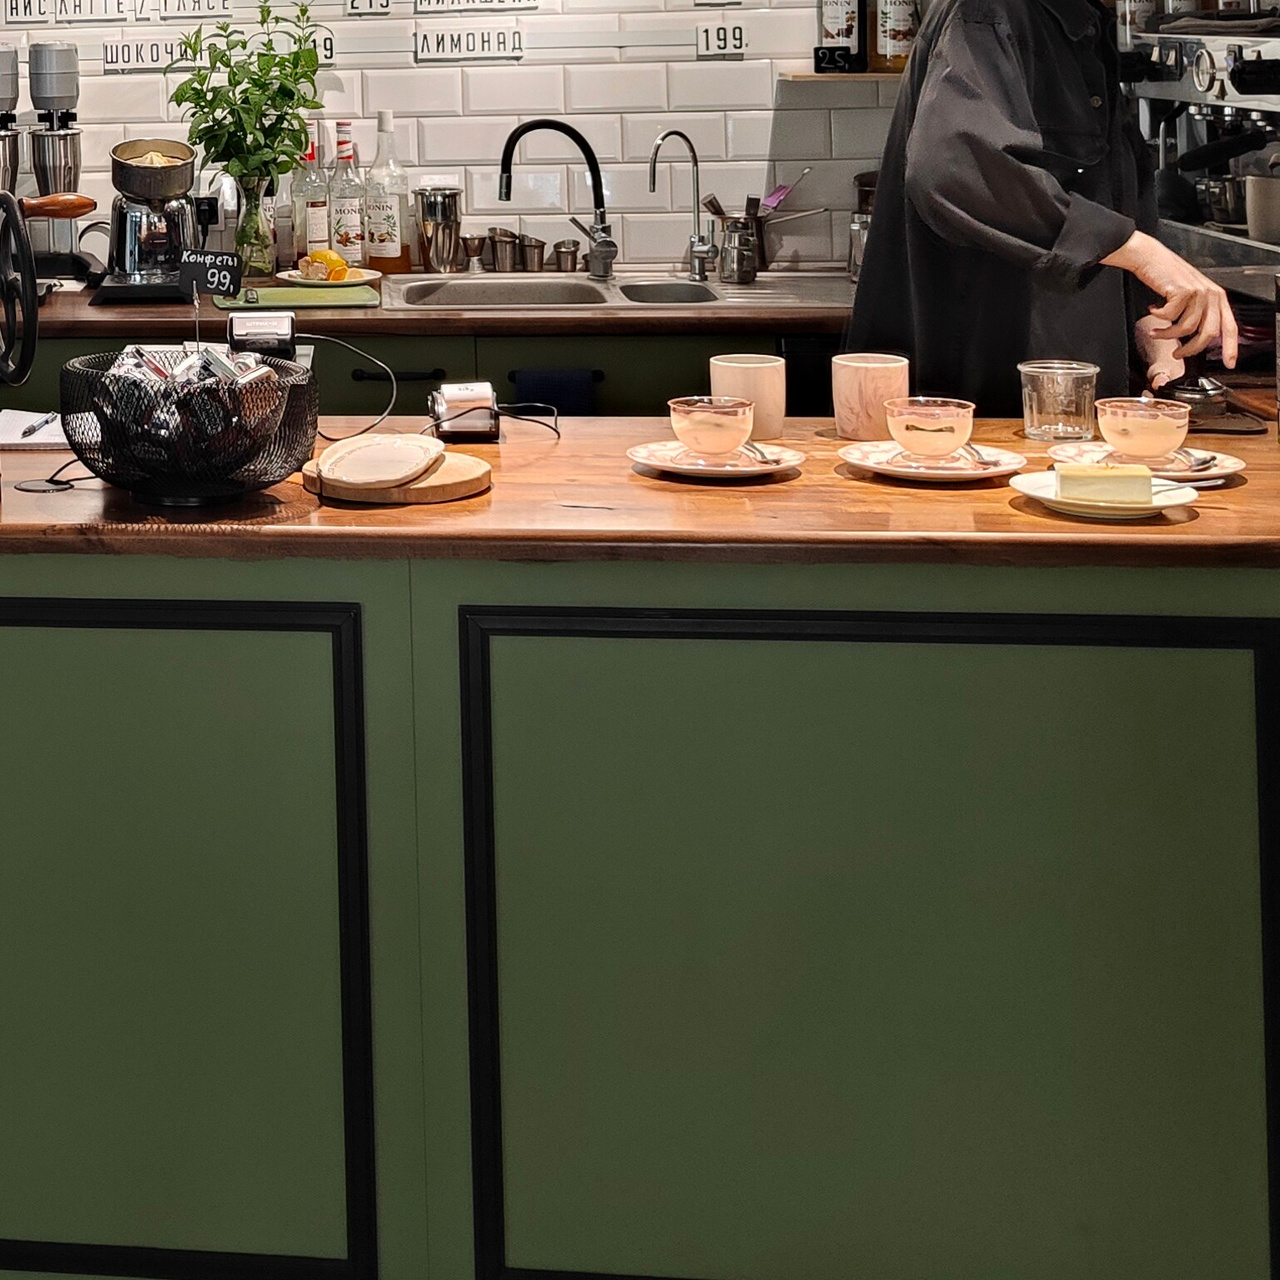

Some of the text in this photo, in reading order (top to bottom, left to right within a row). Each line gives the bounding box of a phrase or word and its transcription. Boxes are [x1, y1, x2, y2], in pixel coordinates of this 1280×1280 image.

[421, 26, 743, 53] ЛИМОНАД 199
[105, 43, 217, 64] ШОКОЧИ
[181, 250, 238, 268] Конфеты
